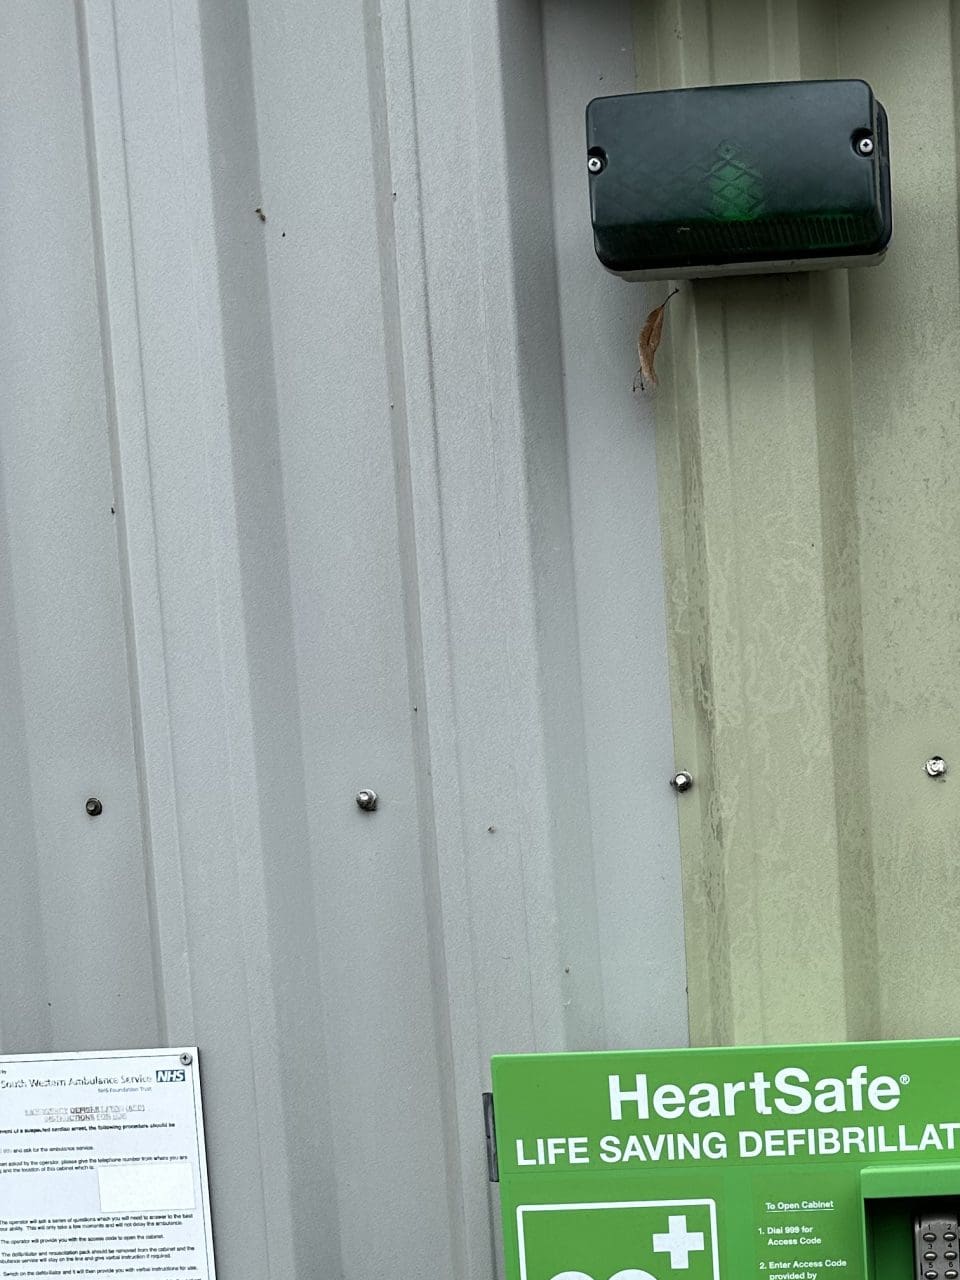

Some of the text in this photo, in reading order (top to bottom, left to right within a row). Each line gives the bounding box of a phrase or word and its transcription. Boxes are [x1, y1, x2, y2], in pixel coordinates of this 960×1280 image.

[0, 1069, 185, 1088] South Western Ambulance Service NHS
[516, 1137, 590, 1166] LIFE
[599, 1132, 727, 1163] SAVING
[765, 1200, 834, 1211] To Open Cabinet
[767, 1226, 783, 1235] Dial
[785, 1226, 800, 1234] 999
[801, 1225, 813, 1233] for
[768, 1236, 822, 1246] Access Code
[759, 1259, 847, 1270] 2. Enter Access Code
[807, 1272, 817, 1280] by
